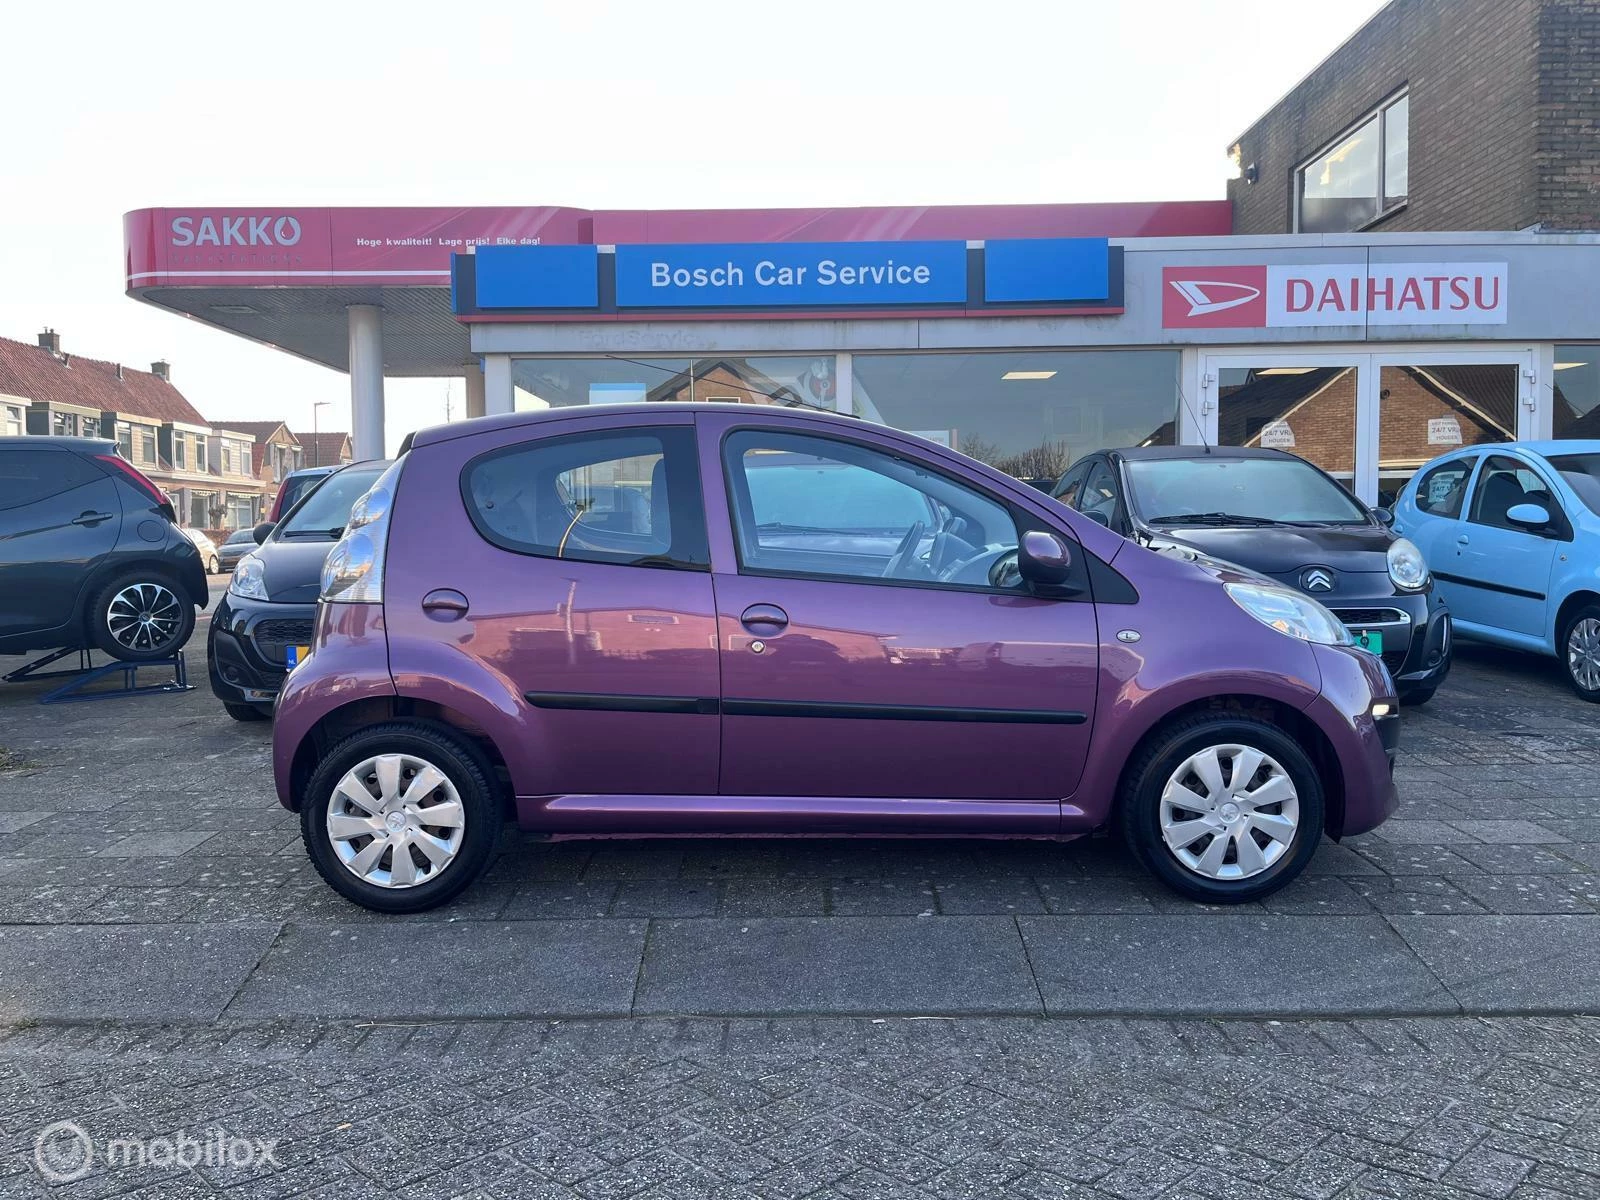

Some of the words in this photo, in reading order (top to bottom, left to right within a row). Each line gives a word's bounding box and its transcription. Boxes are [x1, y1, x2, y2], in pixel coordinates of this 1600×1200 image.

[171, 216, 302, 247] SAKKO
[356, 238, 382, 246] Hoge
[386, 237, 432, 246] kwaliteit!
[438, 238, 463, 246] Lage
[465, 237, 490, 246] prijs!
[496, 237, 517, 245] Elke
[520, 237, 541, 246] dag!
[651, 261, 744, 287] Bosch
[754, 261, 807, 286] Car
[816, 260, 931, 286] Service
[1286, 276, 1499, 312] DAIHATSU
